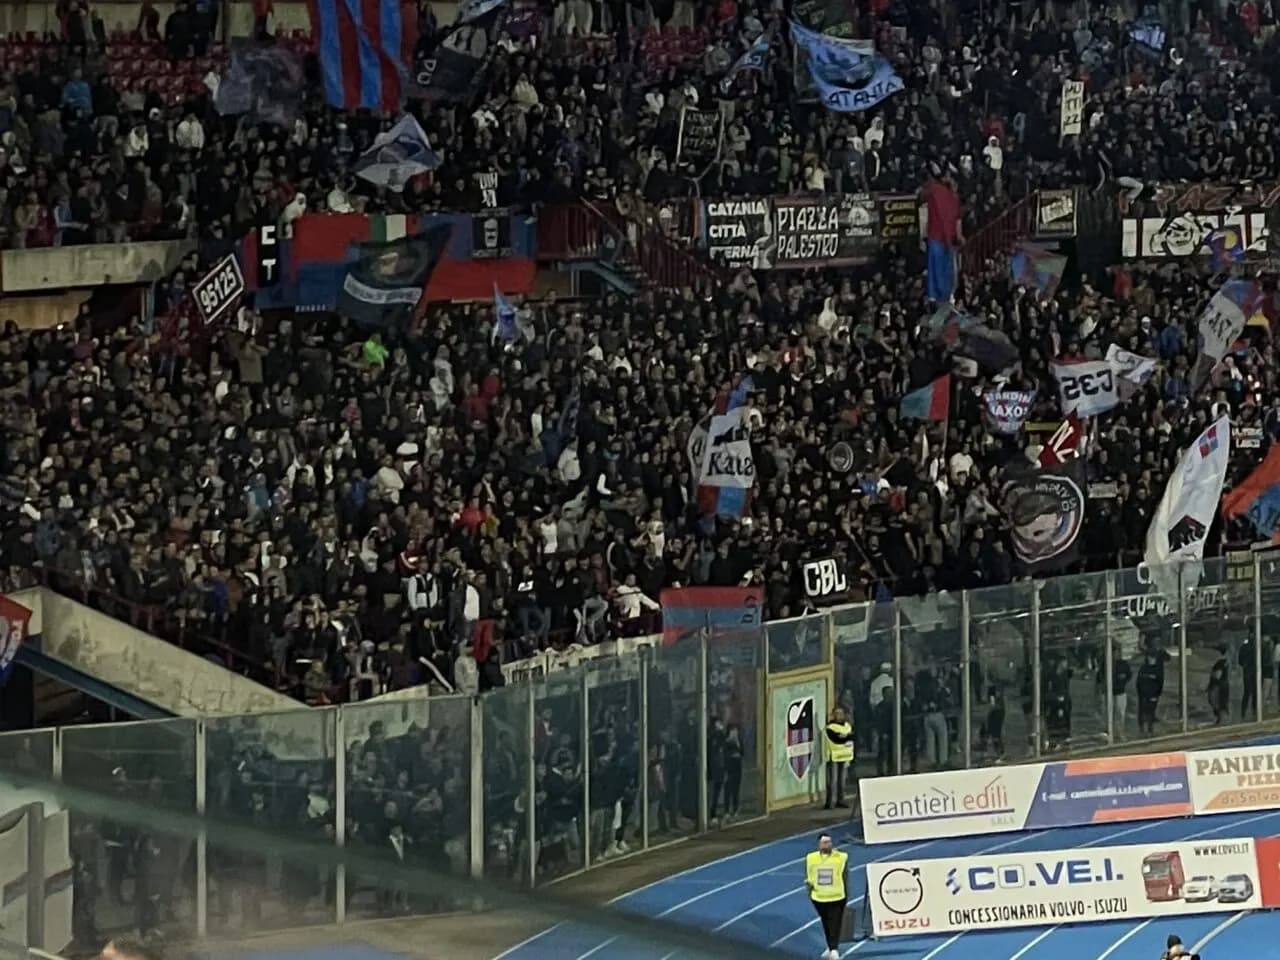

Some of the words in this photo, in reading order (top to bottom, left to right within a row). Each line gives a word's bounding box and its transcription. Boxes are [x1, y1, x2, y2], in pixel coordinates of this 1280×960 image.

[708, 201, 766, 217] CATANIA
[777, 206, 839, 232] PIAZZA
[777, 233, 839, 259] PALESTRO
[201, 264, 237, 313] 95125
[804, 558, 847, 597] CBL
[875, 789, 956, 819] cantieri
[963, 785, 1009, 812] edili
[879, 916, 931, 932] ISUZU
[948, 903, 1047, 926] CONCESSIONARIA
[1050, 900, 1085, 918] VOLVO
[1094, 897, 1128, 915] ISUZU
